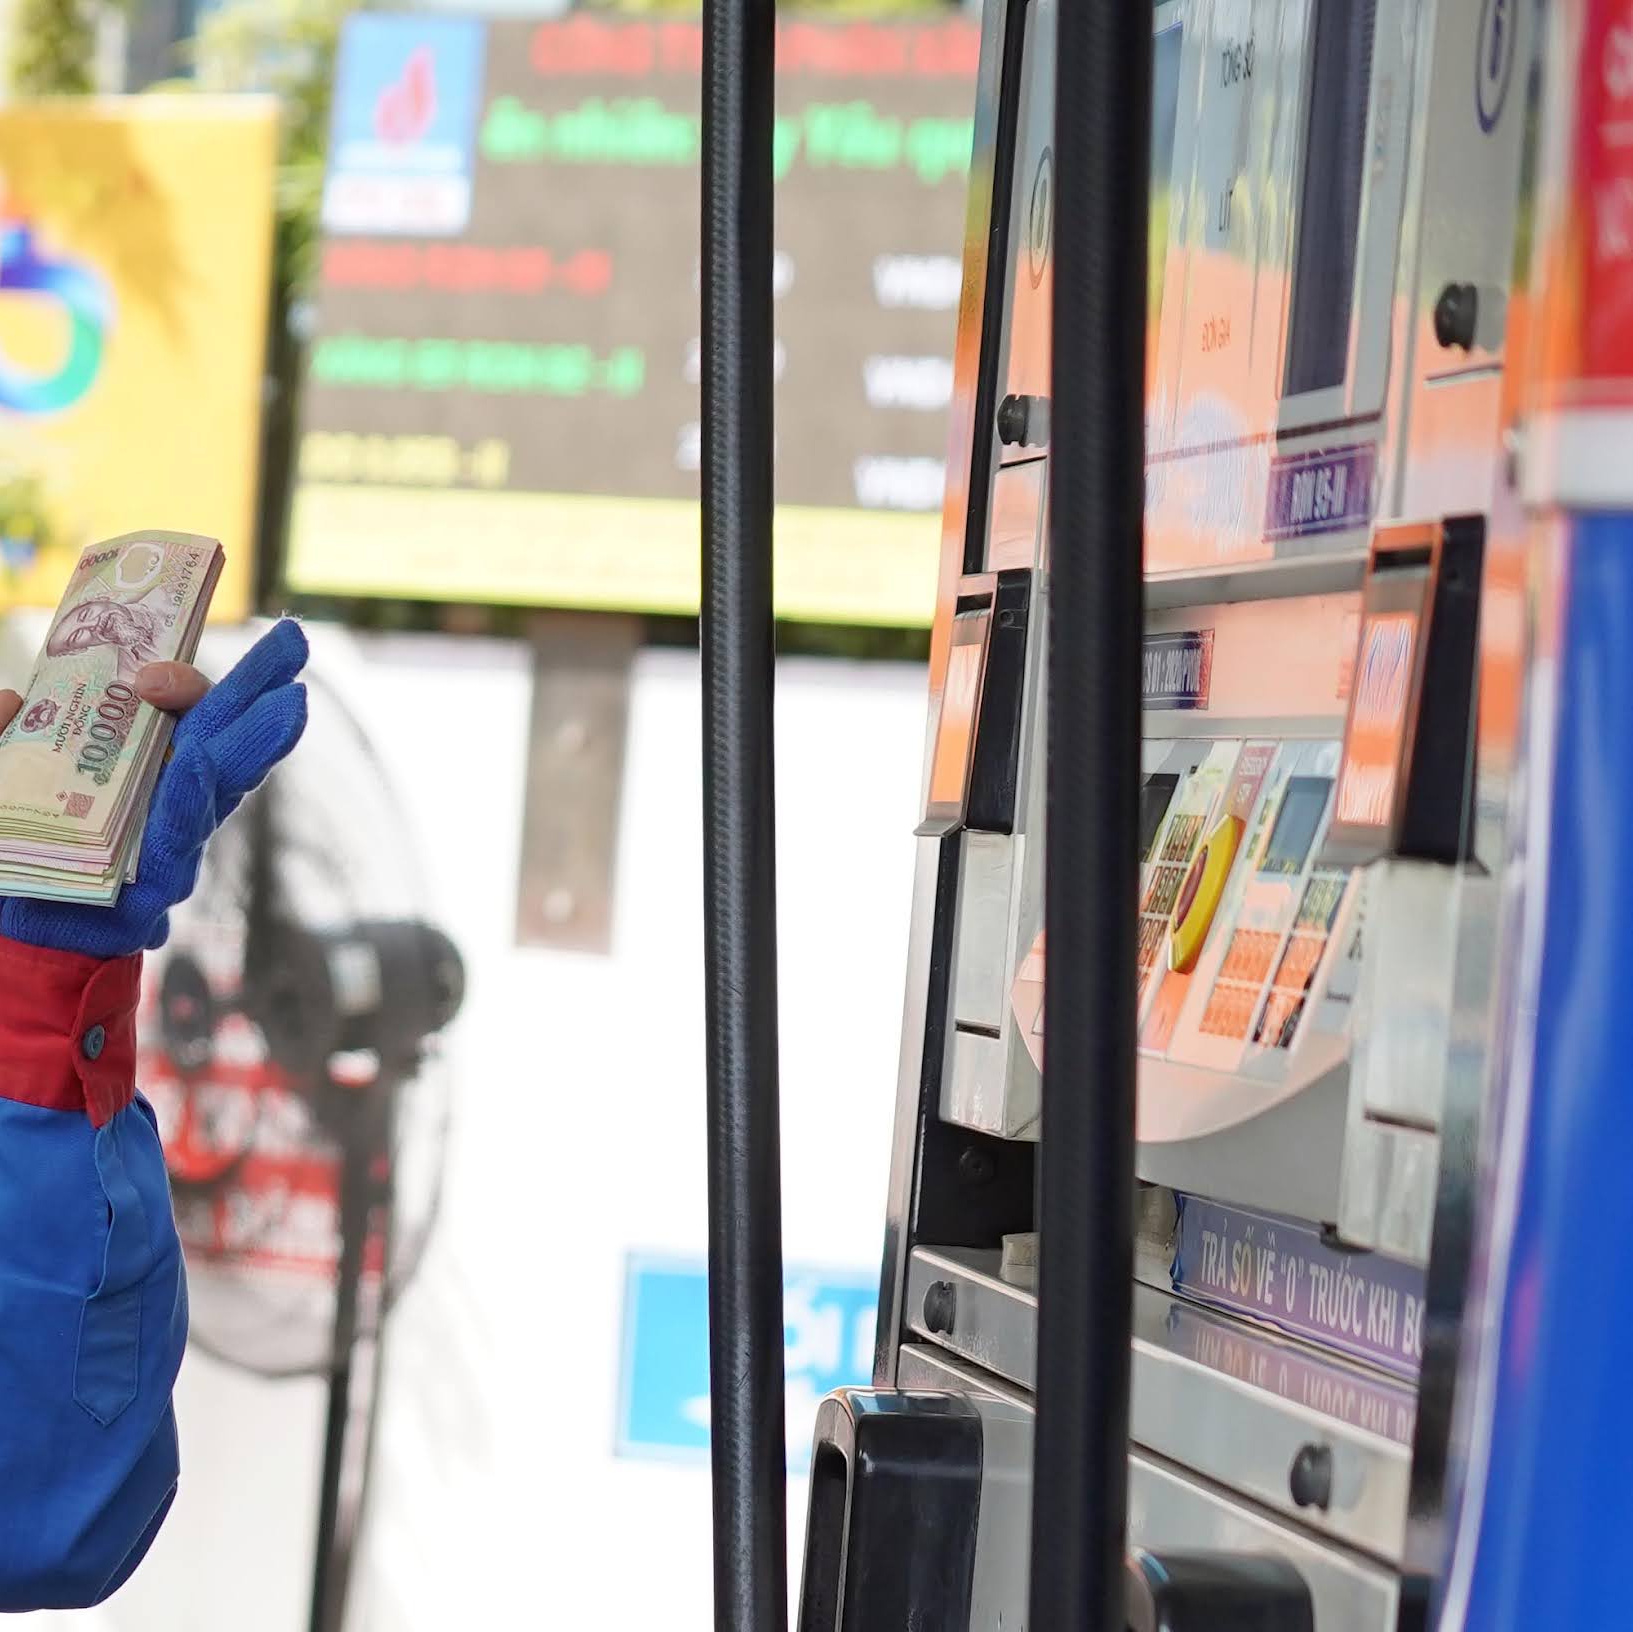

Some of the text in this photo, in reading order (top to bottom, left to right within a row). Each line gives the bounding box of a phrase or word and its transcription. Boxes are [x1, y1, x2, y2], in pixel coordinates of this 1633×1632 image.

[77, 680, 135, 775] 10000
[1201, 1218, 1227, 1289] TRẢ
[1308, 1255, 1365, 1337] TRƯỚC
[1366, 1282, 1398, 1349] KHI
